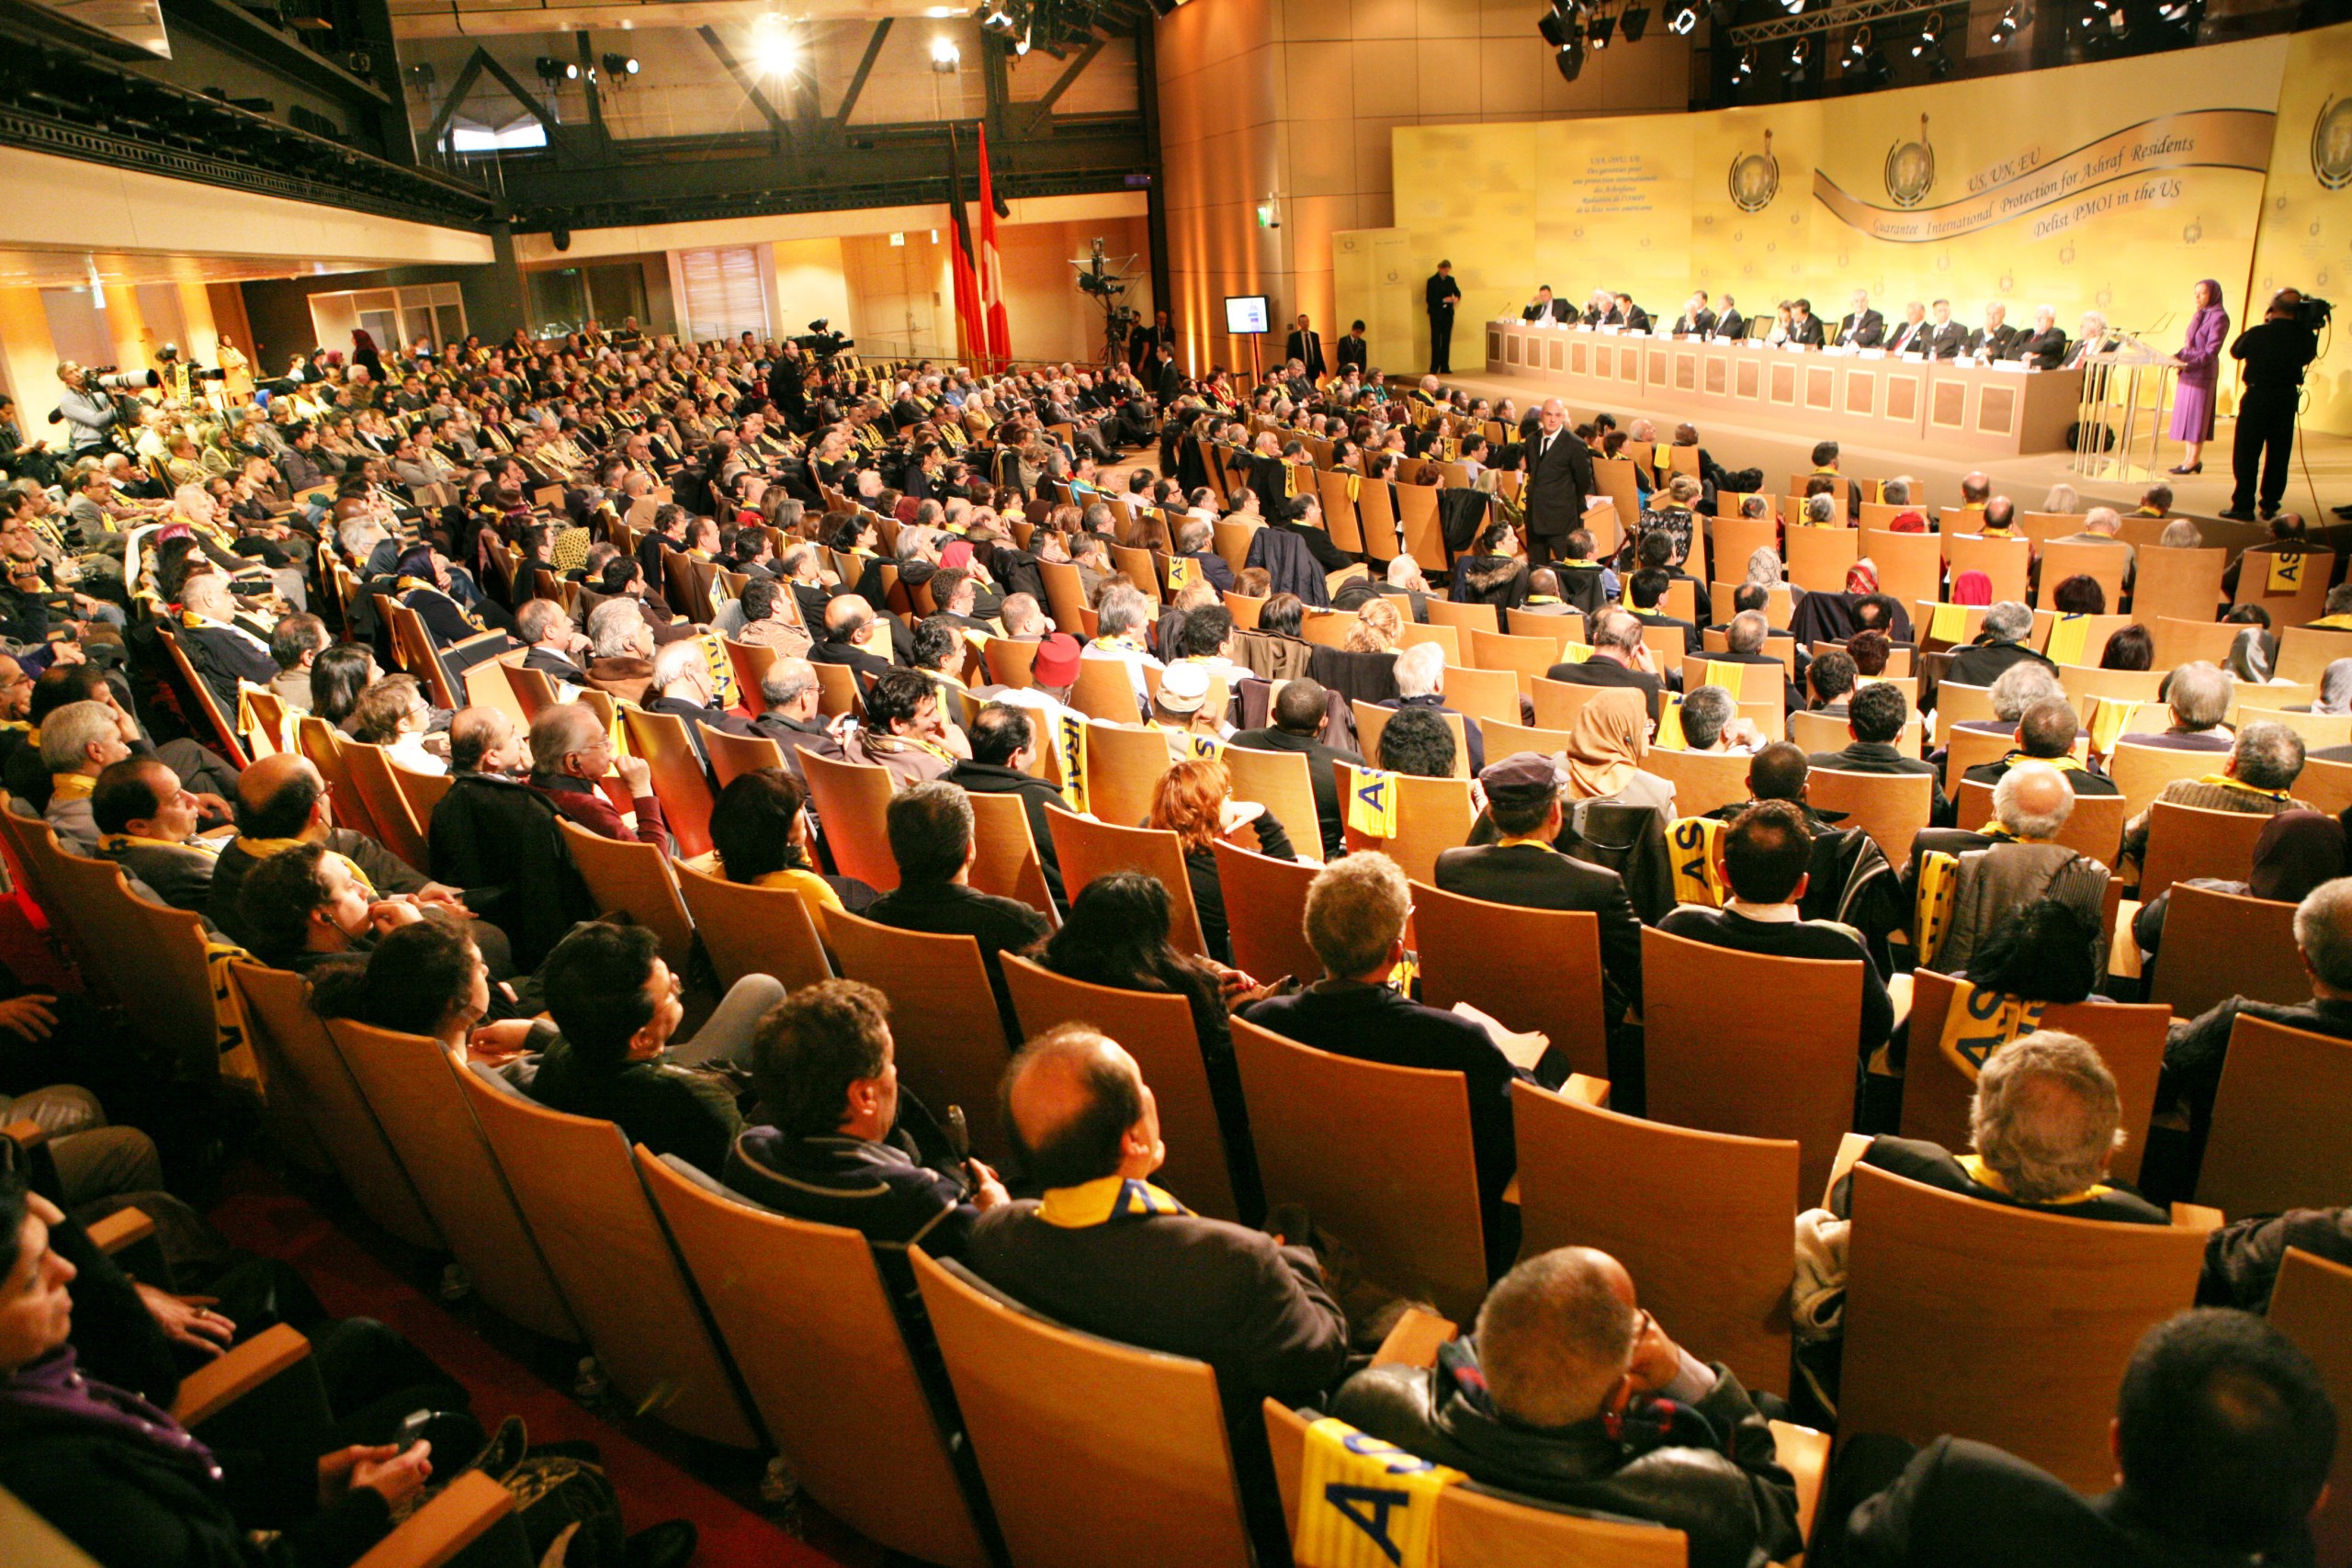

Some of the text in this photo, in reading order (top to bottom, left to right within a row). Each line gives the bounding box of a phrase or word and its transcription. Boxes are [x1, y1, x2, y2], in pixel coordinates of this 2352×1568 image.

[1872, 135, 2195, 236] Guarantee International Protection for Ashraf Residents
[1967, 146, 2041, 192] US, UN, EU
[2033, 177, 2183, 237] Delist PMOI in the US
[2278, 551, 2301, 582] AS
[1358, 768, 1384, 814] A
[1675, 822, 1709, 891] AS
[1325, 1431, 1434, 1568] AS
